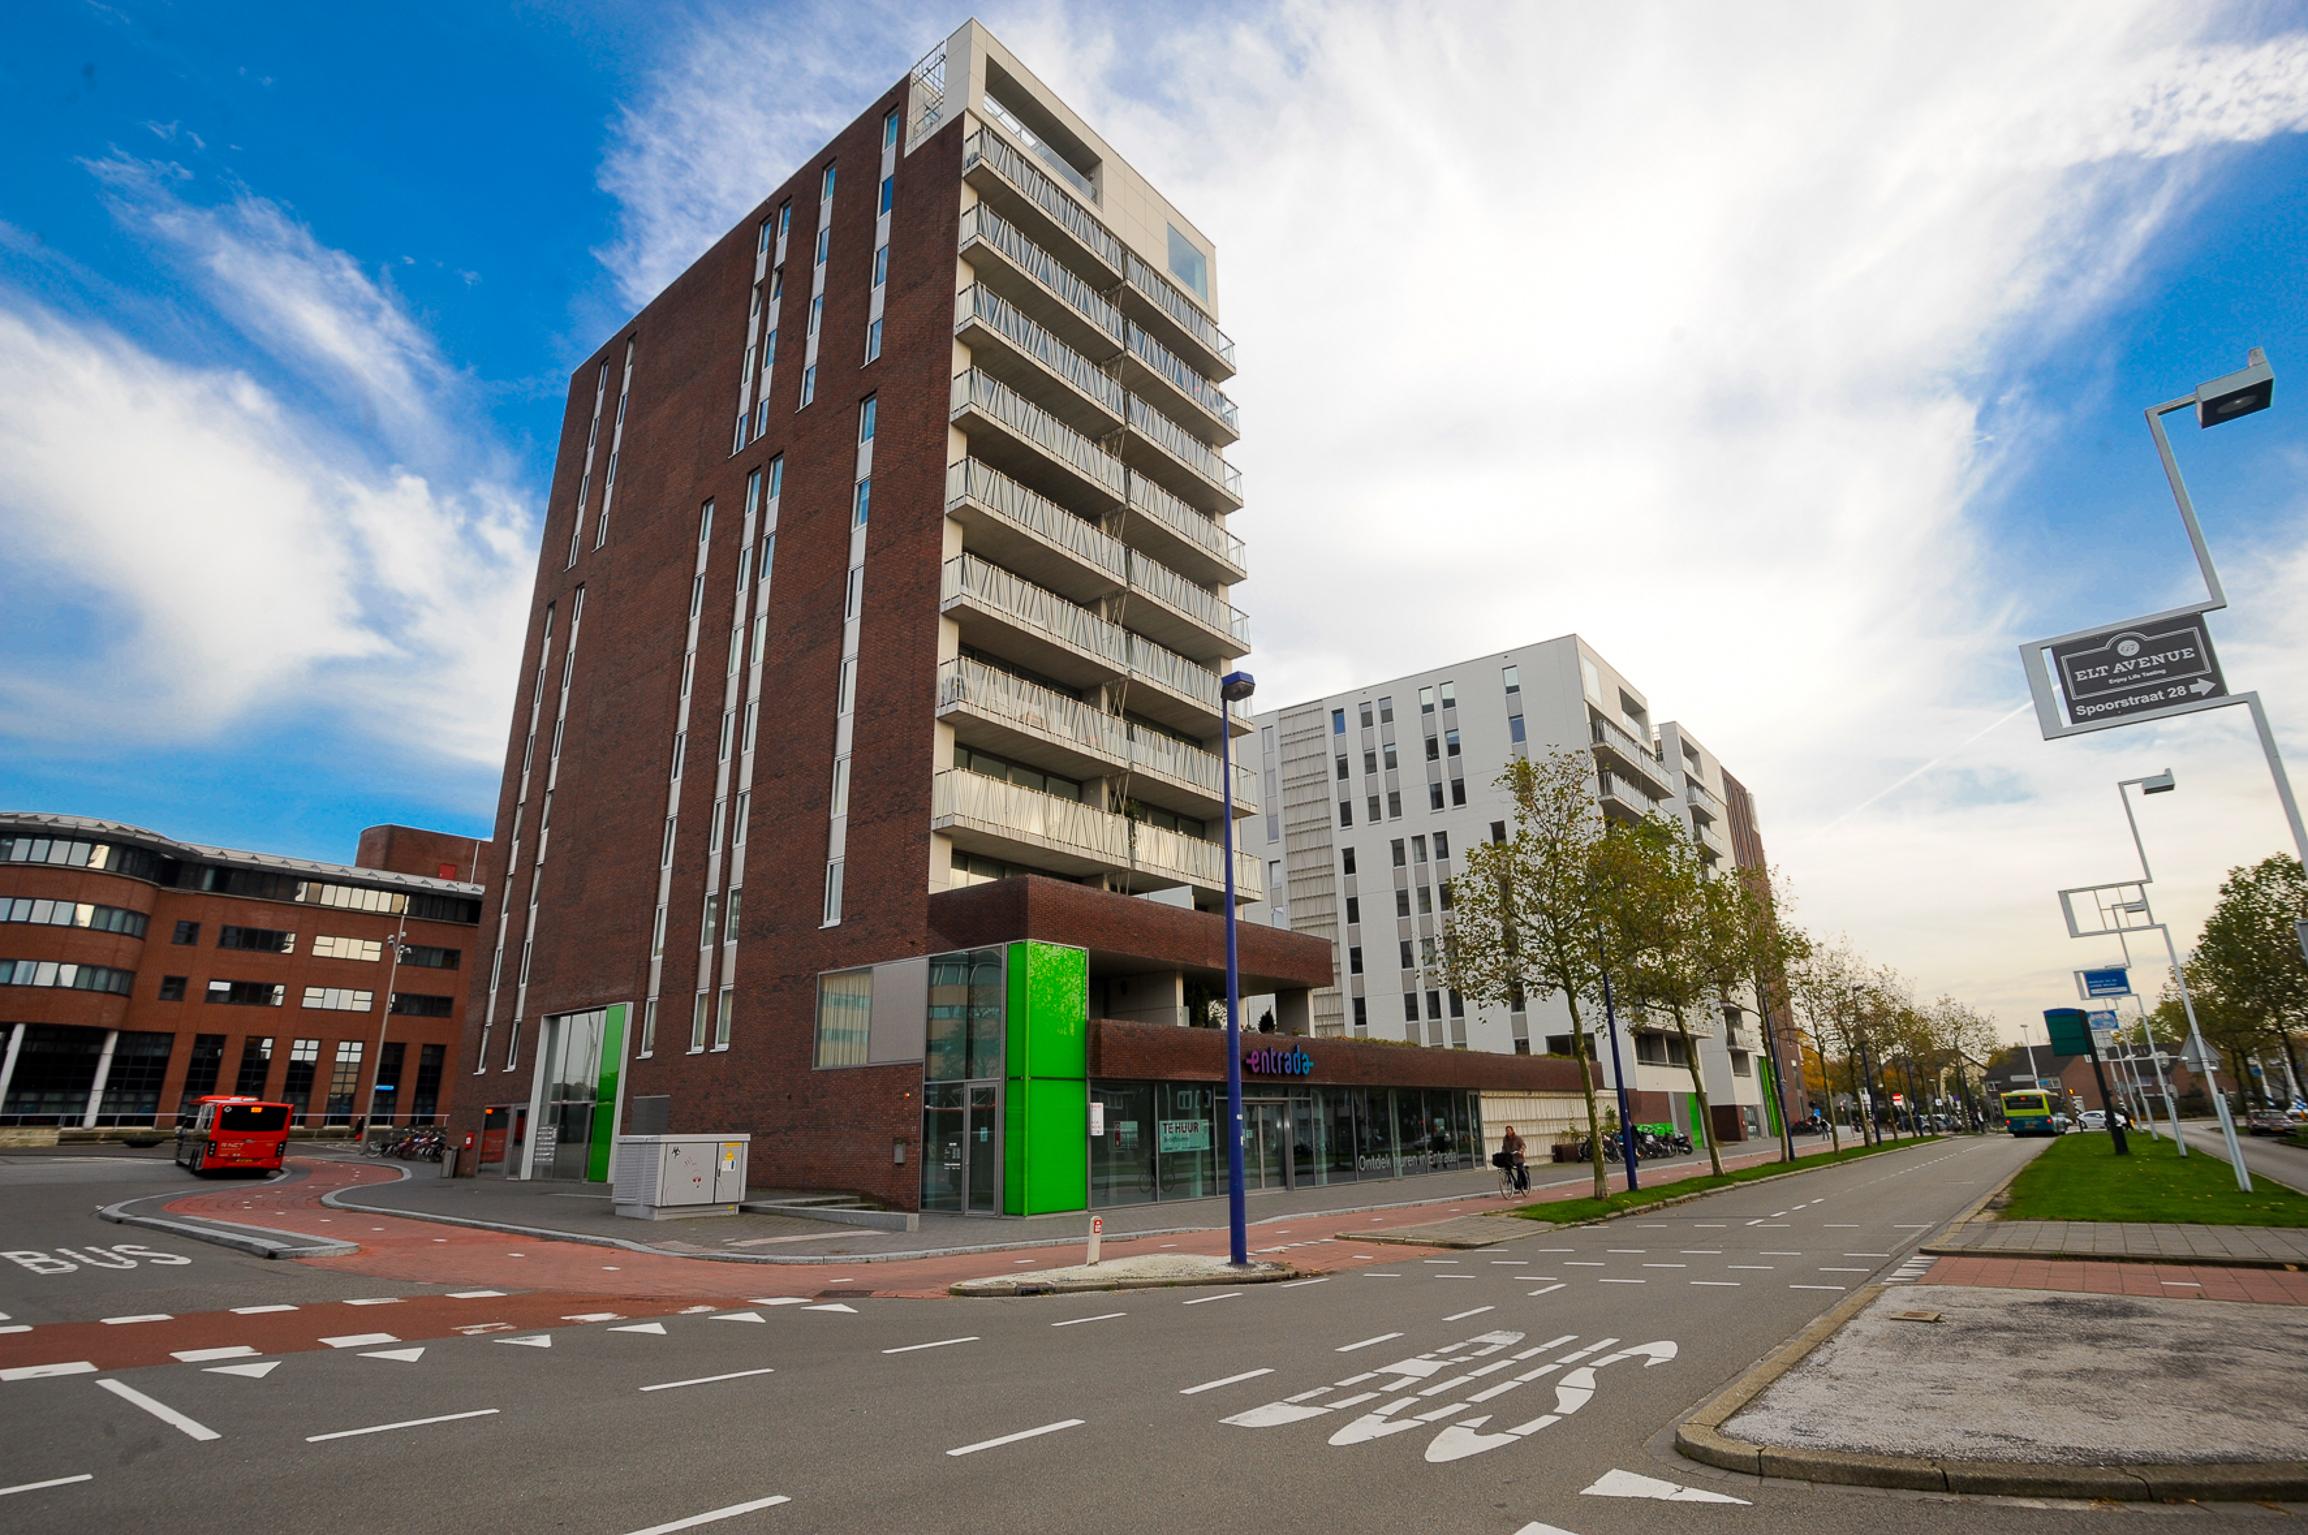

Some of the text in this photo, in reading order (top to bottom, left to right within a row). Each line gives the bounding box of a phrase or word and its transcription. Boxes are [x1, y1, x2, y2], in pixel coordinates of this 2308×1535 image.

[2075, 647, 2196, 681] ELT AVENUE
[2075, 685, 2187, 716] Spoorstraat 28
[1246, 1044, 1314, 1075] entrada
[1163, 1121, 1199, 1134] TE HUUR
[1359, 1153, 1391, 1171] Ontdek
[1428, 1148, 1459, 1165] Entrada
[0, 1245, 192, 1275] BUS
[1218, 1330, 1679, 1463] BUS
